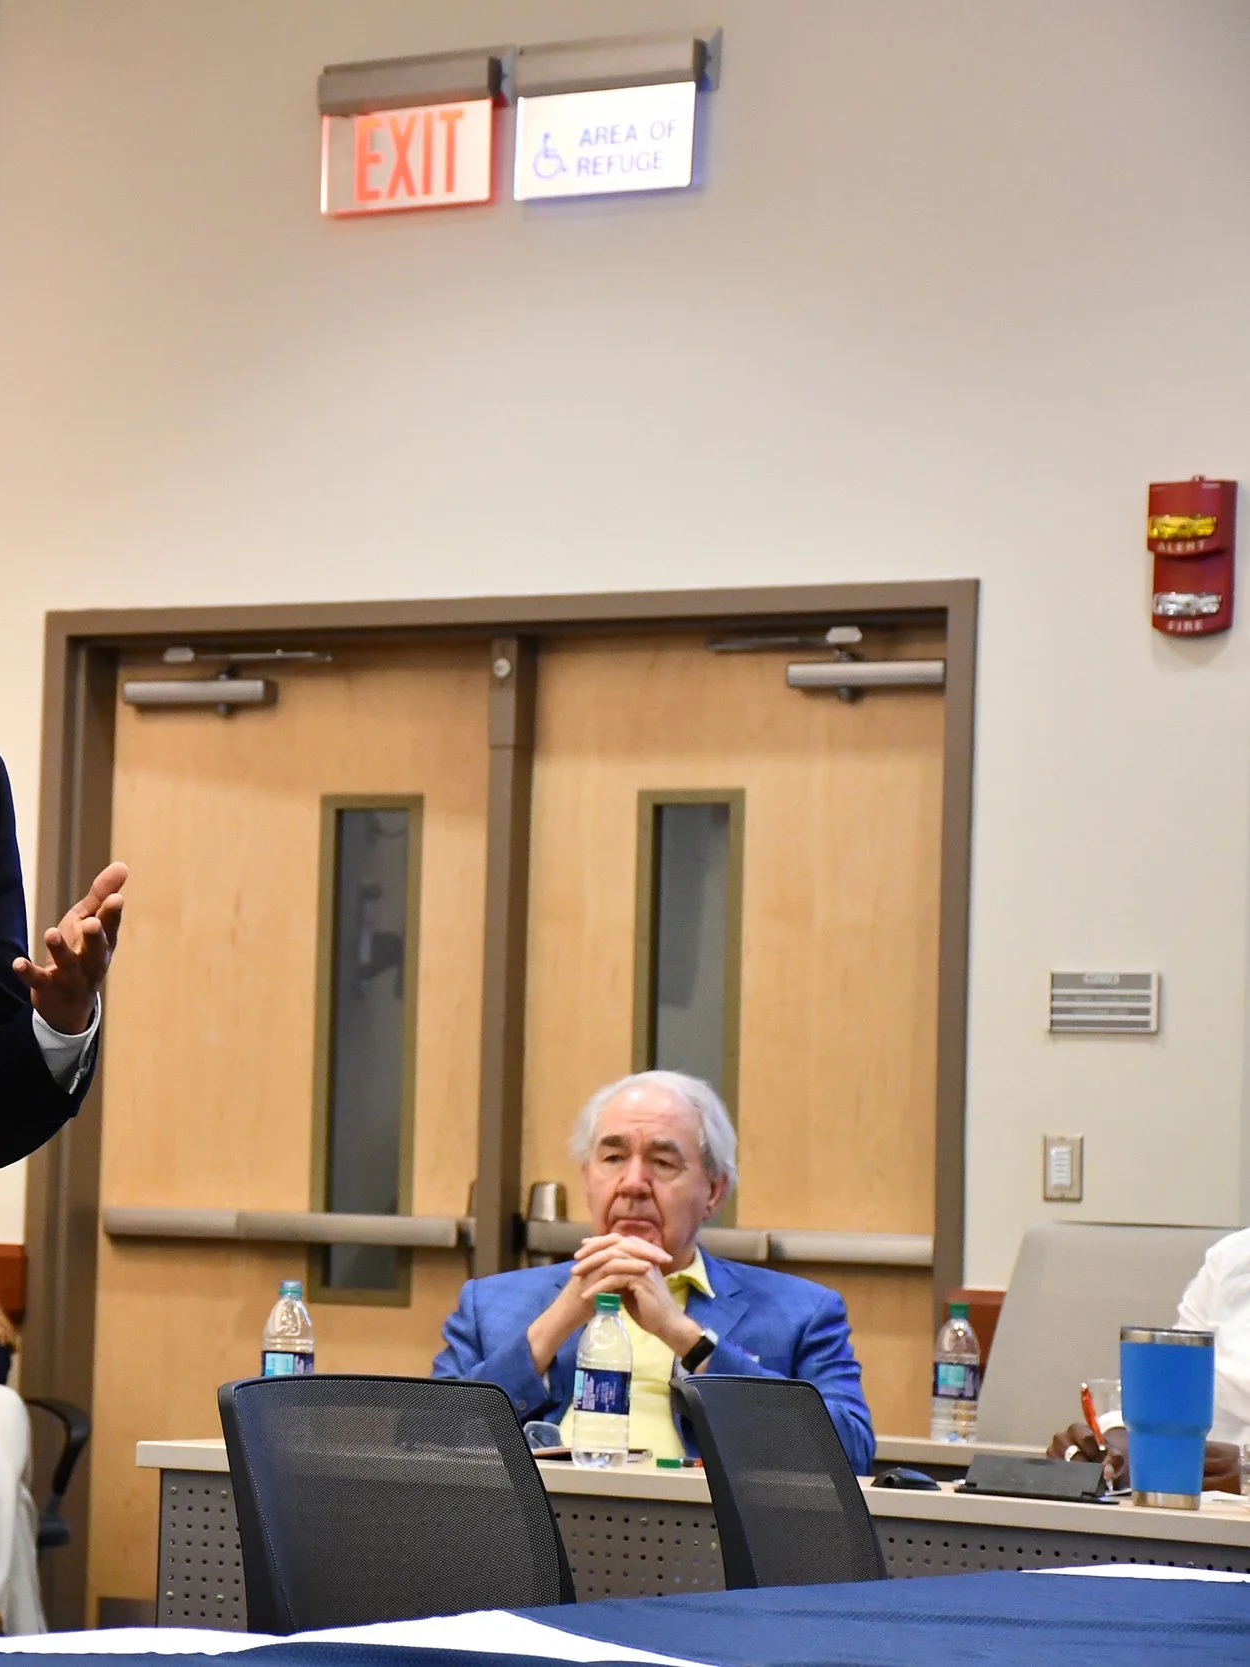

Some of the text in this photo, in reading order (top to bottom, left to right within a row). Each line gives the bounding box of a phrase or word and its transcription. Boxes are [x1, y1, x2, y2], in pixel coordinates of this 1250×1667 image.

[579, 120, 678, 146] AREA OF
[357, 109, 462, 202] EXIT
[577, 151, 664, 175] REFUGE
